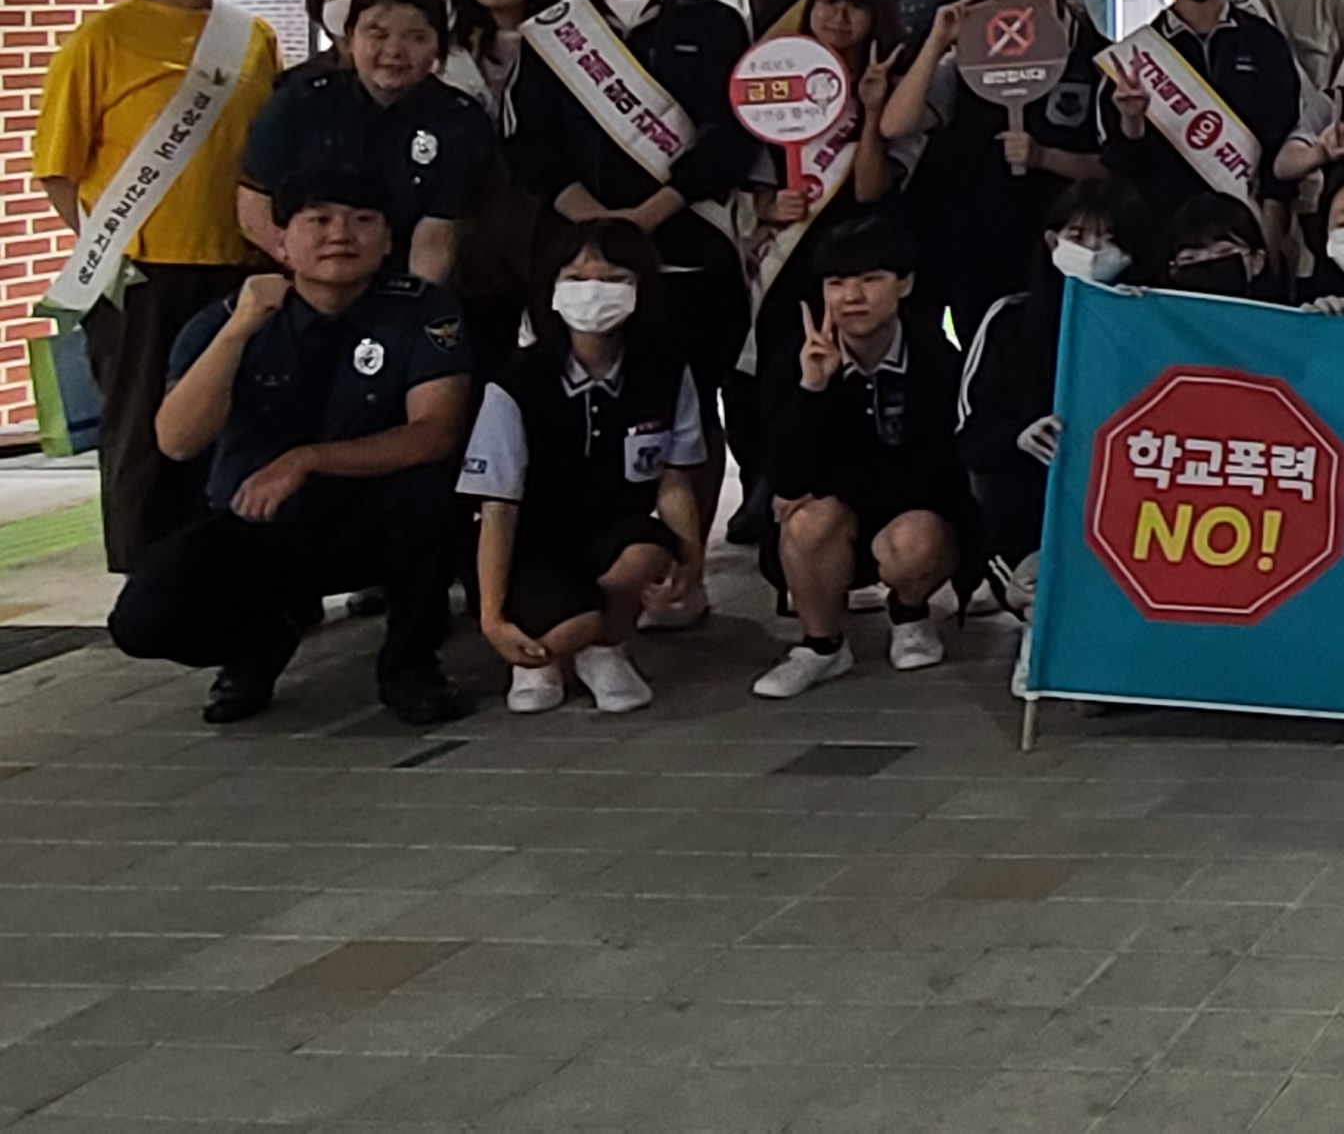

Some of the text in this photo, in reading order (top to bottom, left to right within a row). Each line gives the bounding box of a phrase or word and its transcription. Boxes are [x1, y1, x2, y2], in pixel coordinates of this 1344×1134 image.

[746, 80, 790, 102] 금연
[1189, 113, 1222, 147] NO!
[78, 92, 212, 286] 경상남도 양산교육지원청
[1125, 428, 1318, 501] 학교폭력
[1132, 501, 1283, 572] NO!
